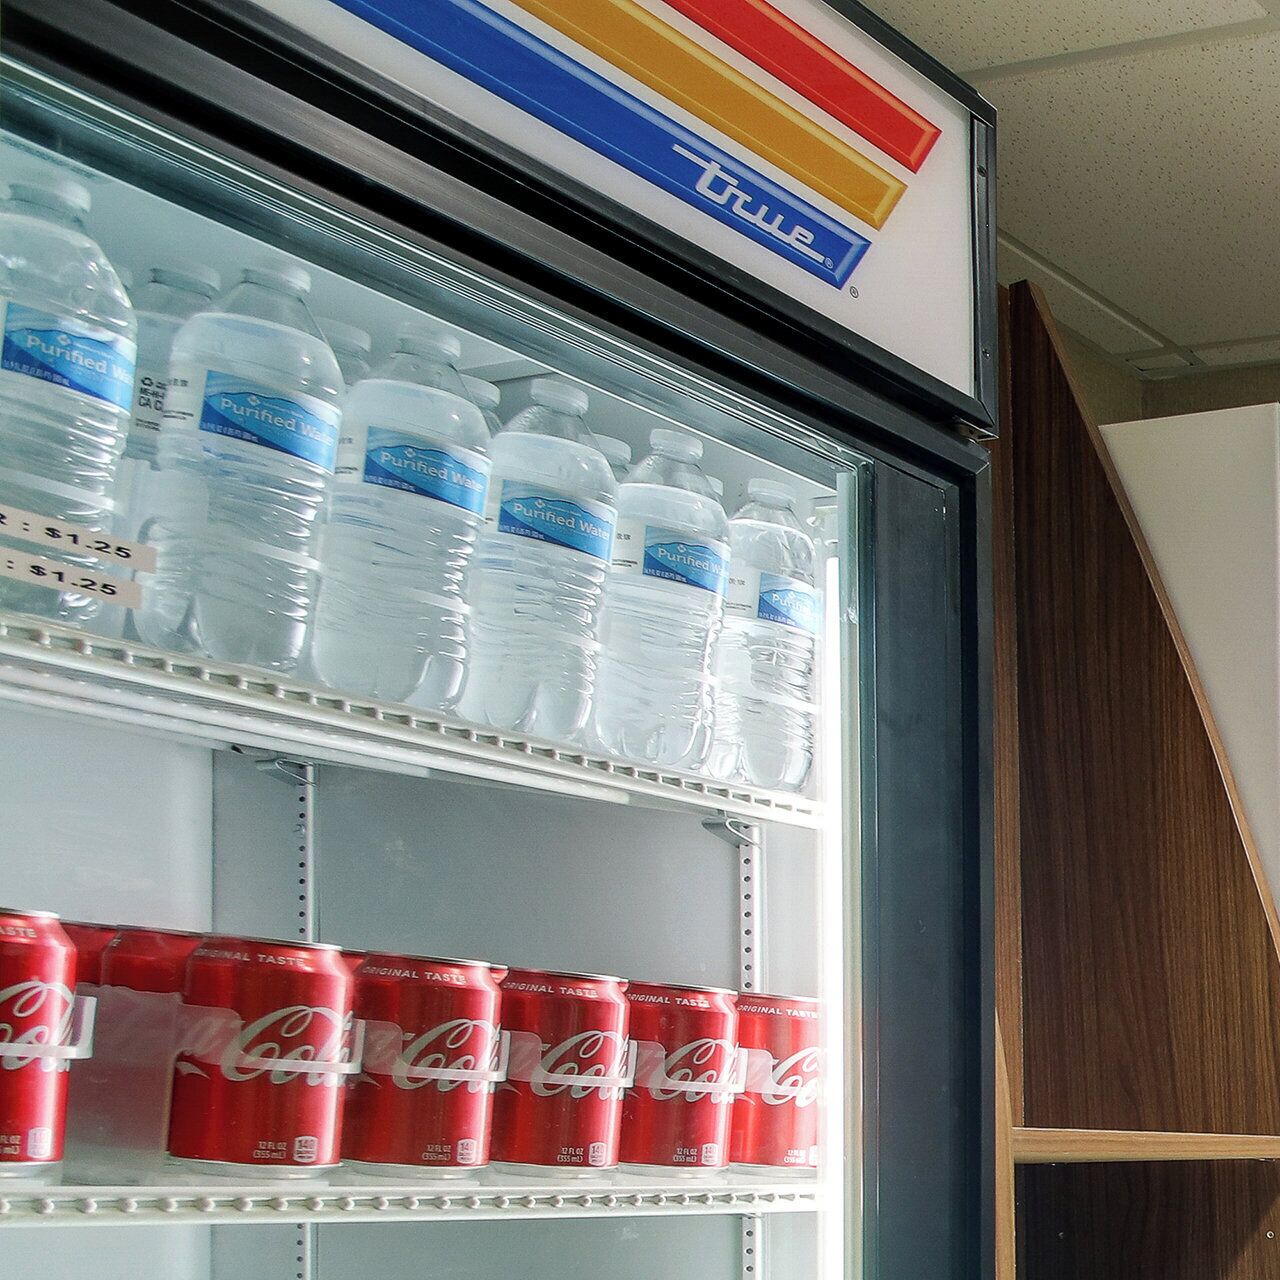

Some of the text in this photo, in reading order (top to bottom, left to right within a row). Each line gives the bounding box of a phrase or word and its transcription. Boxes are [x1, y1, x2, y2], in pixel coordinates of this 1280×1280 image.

[26, 334, 107, 374] Purified
[219, 398, 296, 431] Purified
[380, 452, 448, 480] Purified
[513, 503, 575, 529] Purified
[45, 527, 132, 559] $1.25
[658, 548, 709, 571] Purified
[29, 565, 117, 596] $1.25
[194, 947, 305, 968] ORIGINAL TASTE
[362, 966, 467, 983] ORIGINAL TASTE
[503, 981, 599, 999] ORIGINAL TASTE
[626, 992, 712, 1009] ORIGINAL TASTE
[737, 1003, 819, 1019] ORIGINAL TASTE
